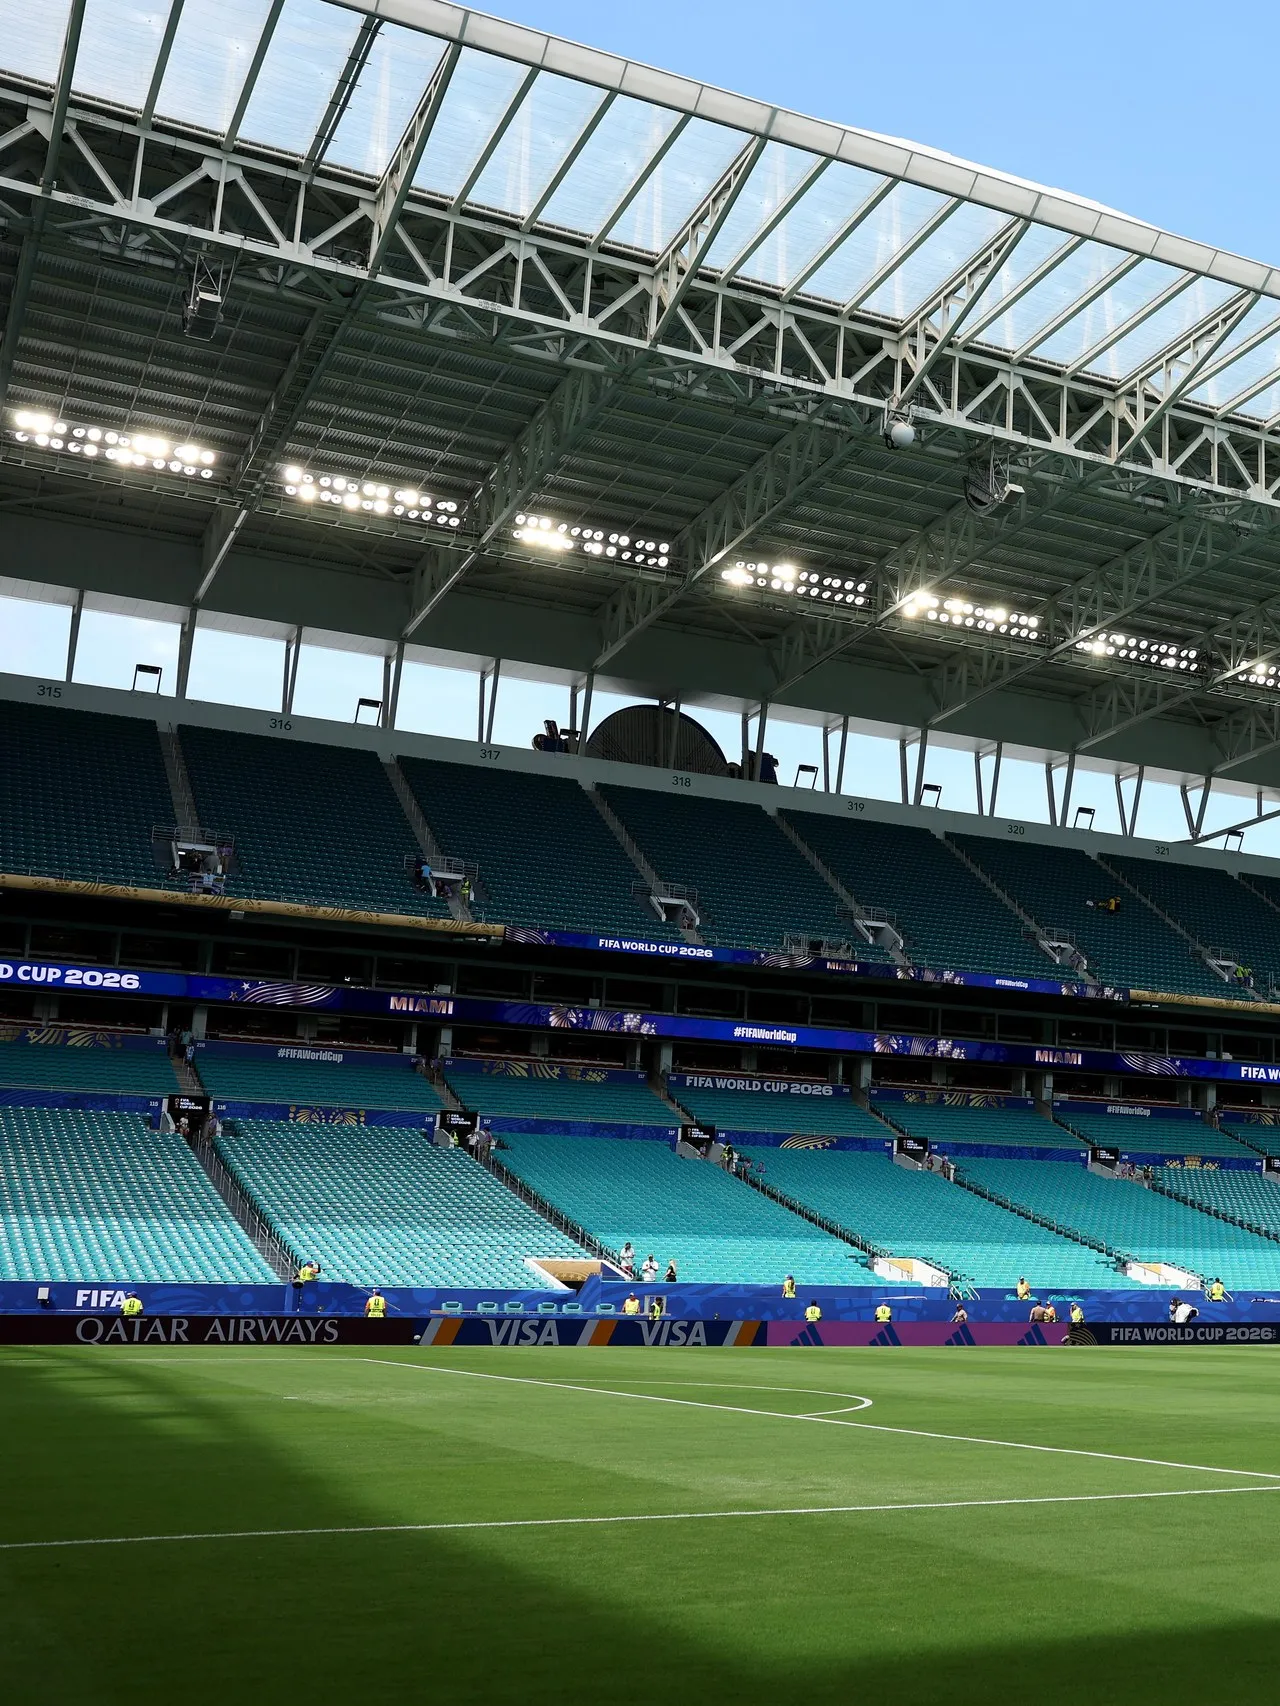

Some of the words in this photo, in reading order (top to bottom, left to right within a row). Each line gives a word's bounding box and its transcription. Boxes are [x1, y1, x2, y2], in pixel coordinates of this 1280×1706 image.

[37, 685, 62, 698] 315
[269, 717, 292, 731] 316
[480, 748, 501, 761] 317
[672, 776, 691, 788] 318
[847, 801, 865, 813] 319
[1007, 824, 1025, 836] 320
[1155, 845, 1171, 856] 321
[599, 939, 621, 949] FIFA
[622, 941, 657, 953] WORLD
[659, 945, 679, 955] CUP
[679, 947, 713, 958] 2026
[827, 961, 858, 972] MIAMI
[18, 965, 62, 983] CUP
[64, 969, 140, 990] 2026
[995, 979, 1029, 989] #FIFAWorldCup
[390, 996, 454, 1015] MIAMI
[734, 1027, 797, 1043] #FIFAWorldCup
[278, 1048, 343, 1064] #FIFAWorldCup
[1036, 1050, 1082, 1065] MIAMI
[1241, 1067, 1267, 1080] FIFA
[686, 1076, 713, 1088] FIFA
[716, 1078, 761, 1093] WORLD
[763, 1082, 789, 1094] CUP
[790, 1084, 834, 1097] 2026
[1107, 1105, 1151, 1117] #FIFAWorldCup
[76, 1290, 125, 1308] FIFA
[76, 1318, 190, 1345] QATAR
[205, 1319, 340, 1343] AIRWAYS
[482, 1319, 560, 1346] VISA
[635, 1320, 707, 1346] VISA
[1111, 1328, 1141, 1341] FIFA
[1143, 1328, 1195, 1341] WORLD
[1197, 1328, 1225, 1341] CUP
